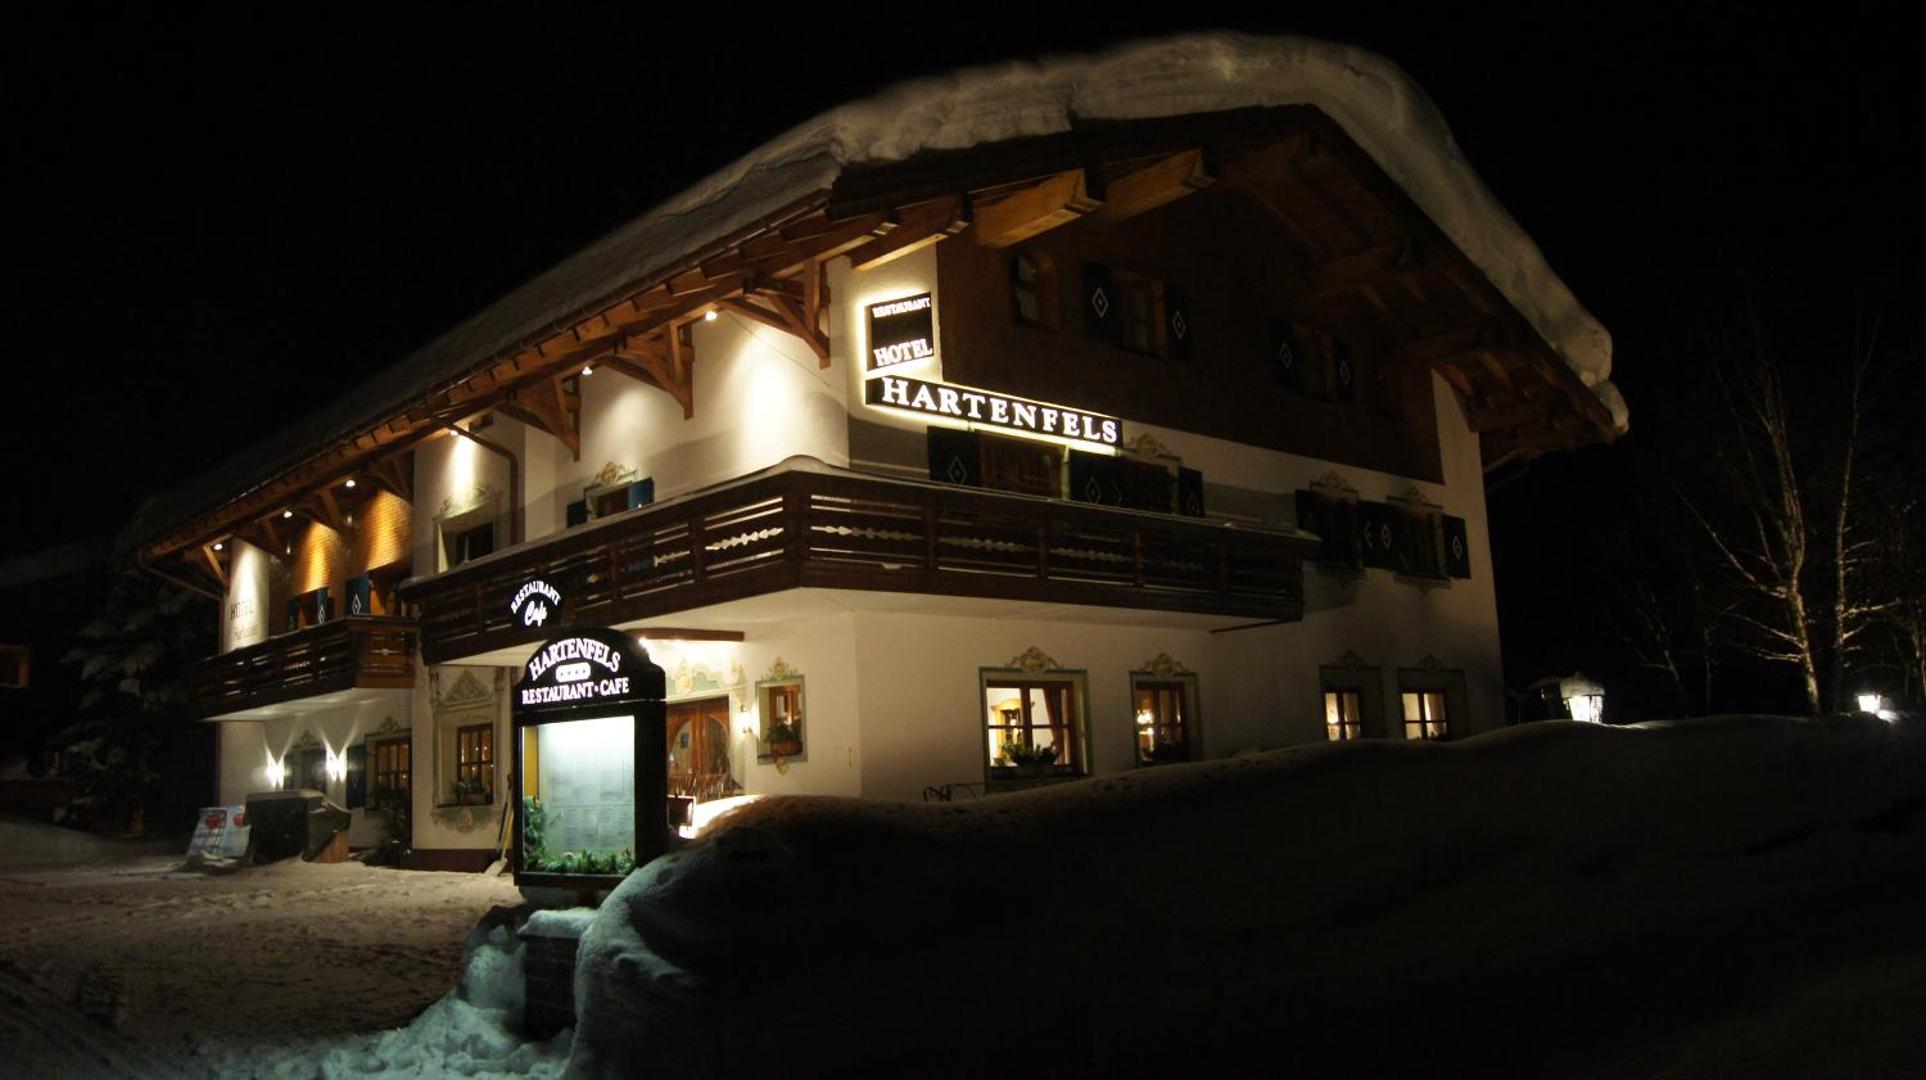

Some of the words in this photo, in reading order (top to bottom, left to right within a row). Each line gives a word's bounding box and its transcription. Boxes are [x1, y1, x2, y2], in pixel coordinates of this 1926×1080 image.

[873, 338, 933, 367] HOTEL
[881, 377, 1118, 443] HARTENFELS
[510, 580, 562, 614] RESTAURANT
[528, 637, 621, 681] HARTENFELS
[521, 681, 595, 704] RESTAURANT
[600, 677, 629, 696] CAFE
